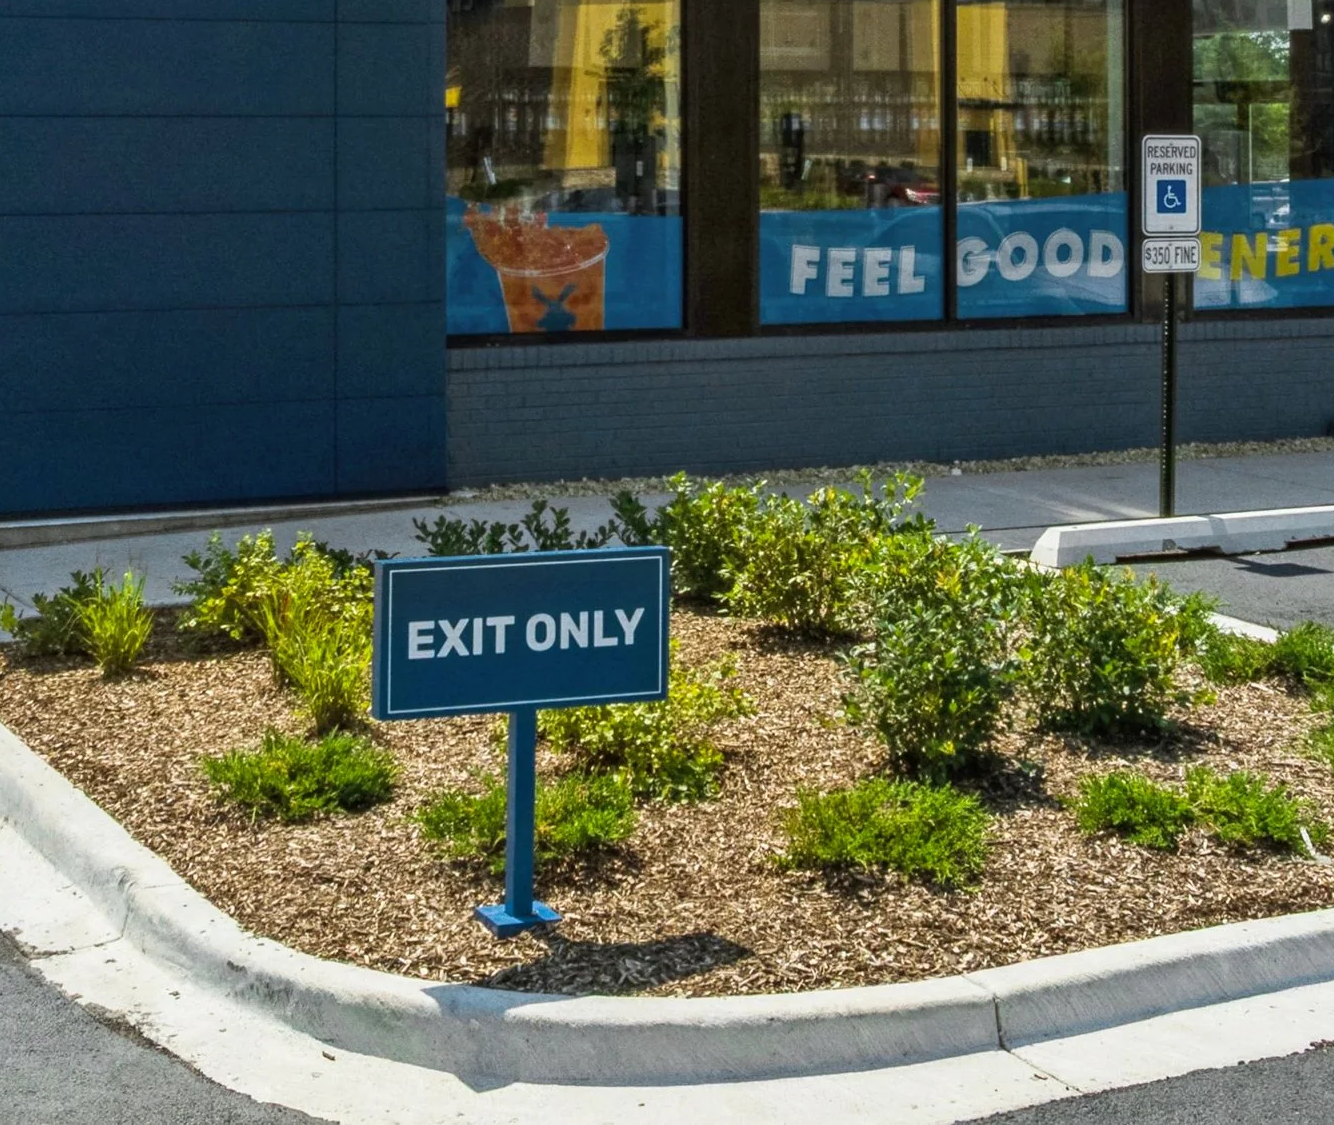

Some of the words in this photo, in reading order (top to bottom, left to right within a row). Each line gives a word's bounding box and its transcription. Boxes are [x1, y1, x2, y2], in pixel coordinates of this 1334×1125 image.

[1147, 145, 1197, 159] RESERVED
[1150, 162, 1193, 175] PARKING
[790, 243, 925, 298] FEEL
[955, 227, 1124, 288] GOOD
[1145, 246, 1171, 265] $350
[1174, 246, 1197, 264] FINE
[407, 614, 516, 660] EXIT
[525, 607, 646, 653] ONLY
